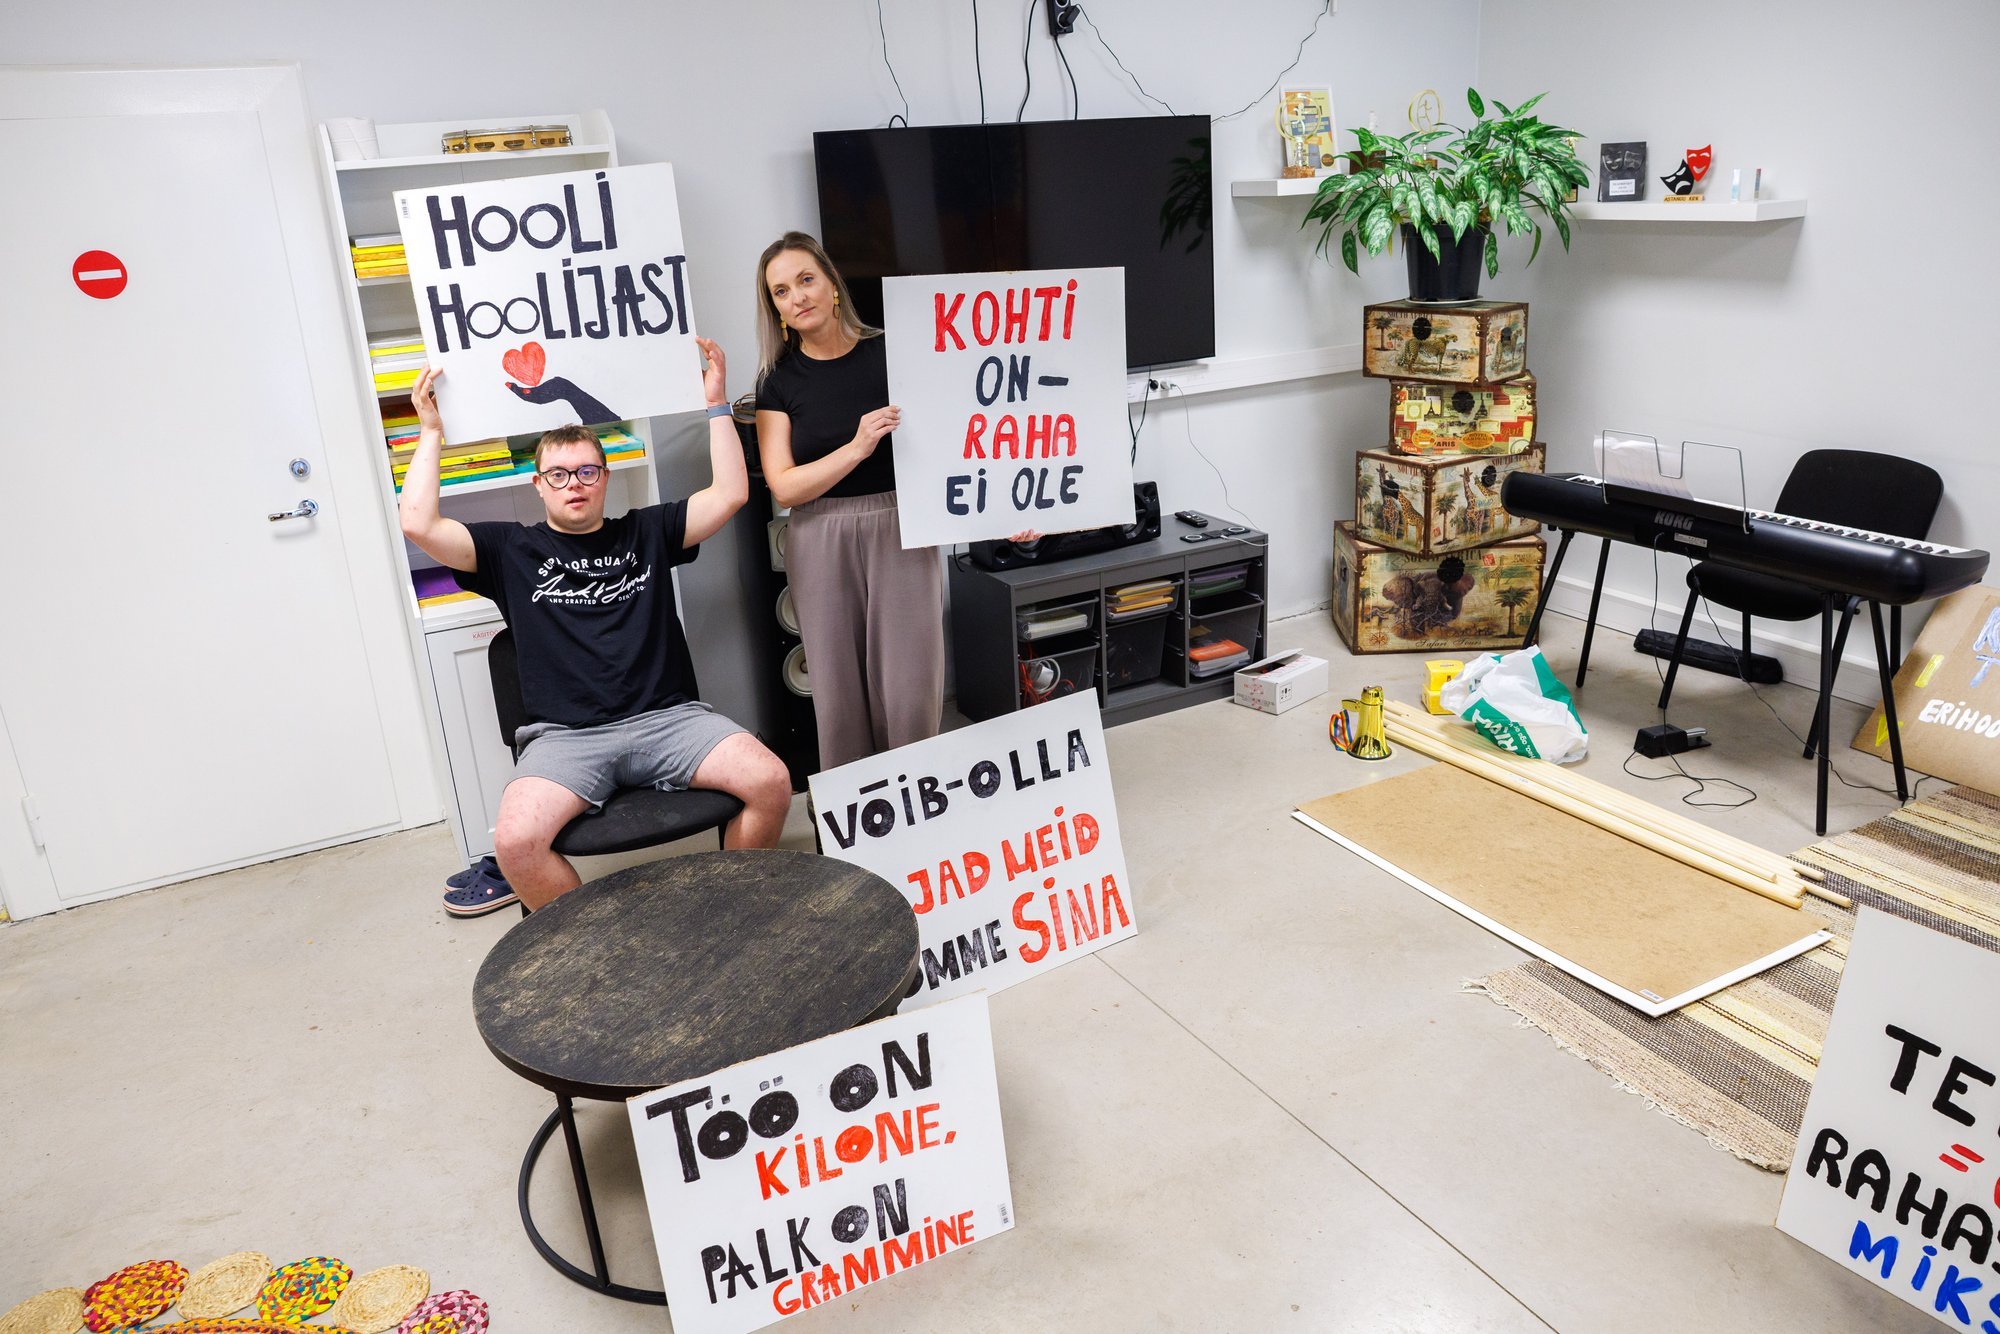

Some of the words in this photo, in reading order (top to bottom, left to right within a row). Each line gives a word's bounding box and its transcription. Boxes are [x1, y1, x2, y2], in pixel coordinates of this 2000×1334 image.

[963, 413, 1077, 459] RAHA
[1012, 465, 1083, 511] OLE
[1654, 511, 1695, 531] KORG
[645, 1075, 799, 1183] TÖÖ
[829, 1032, 932, 1112] ON
[701, 1216, 821, 1304] PALK
[831, 1178, 910, 1243] ON
